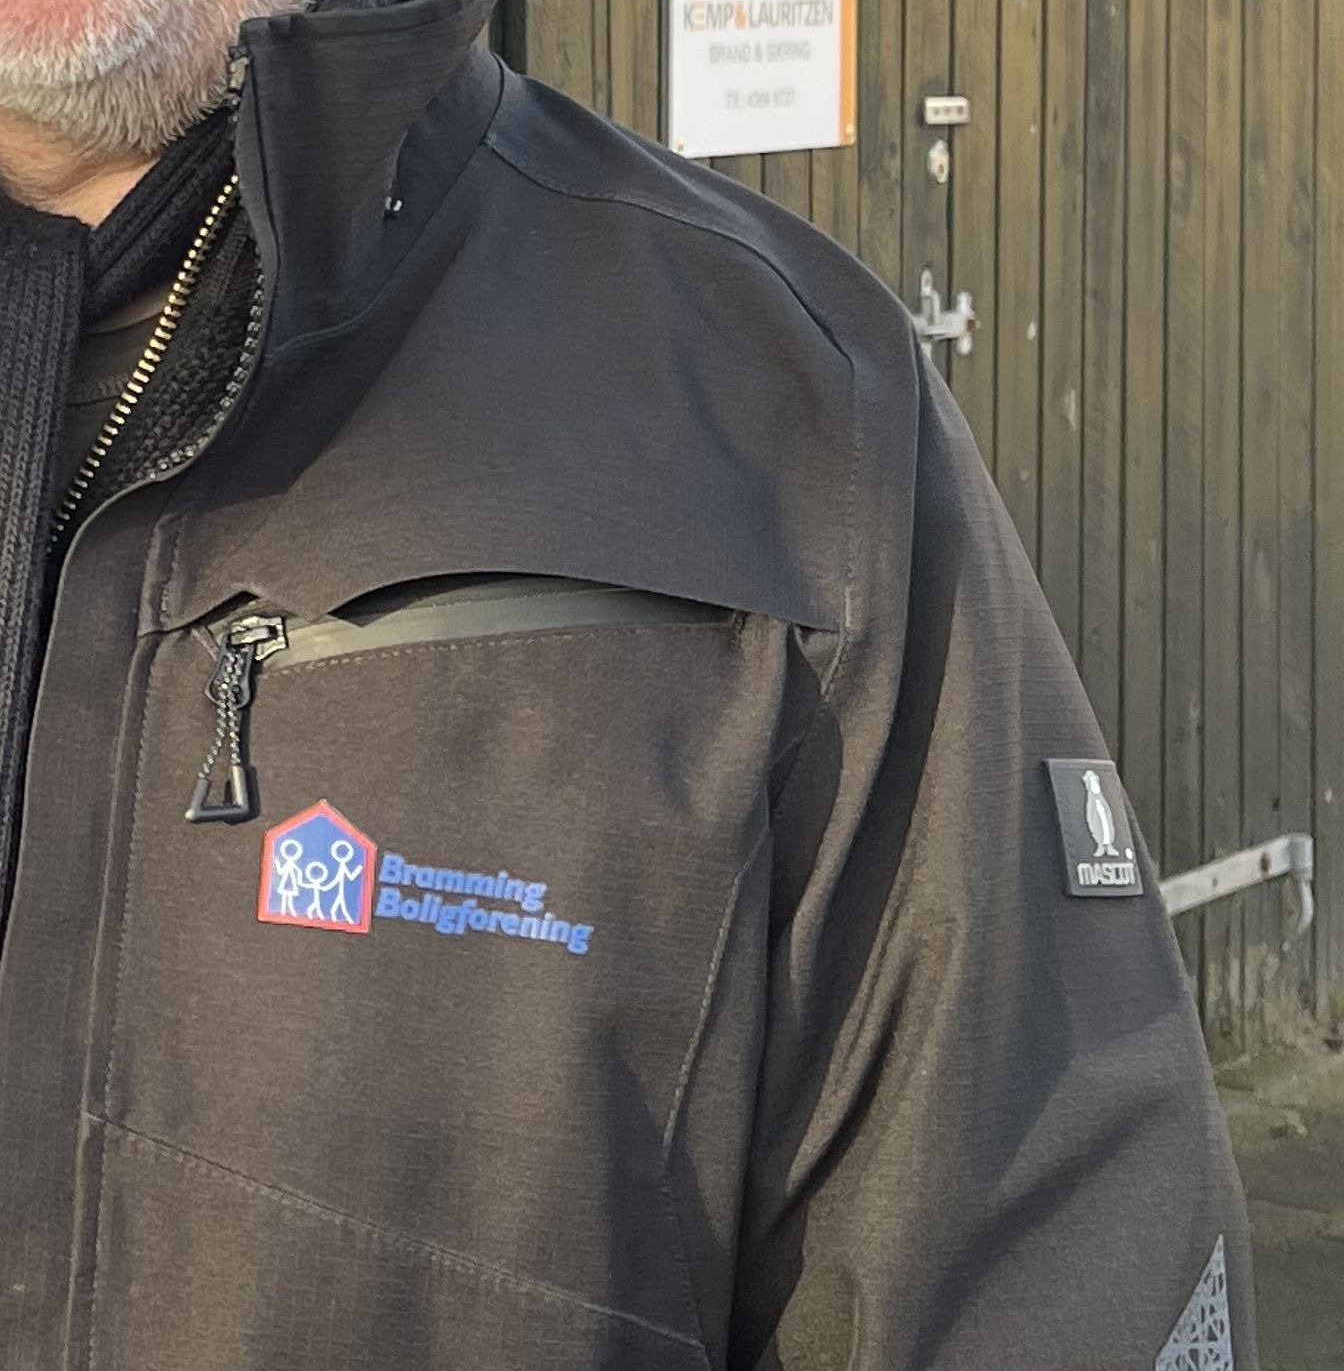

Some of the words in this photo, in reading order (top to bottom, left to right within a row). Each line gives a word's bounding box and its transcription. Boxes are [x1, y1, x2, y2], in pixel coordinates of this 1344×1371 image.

[378, 852, 548, 912] Bramming
[1077, 862, 1135, 886] MASCOT
[375, 886, 594, 955] Boligforening
